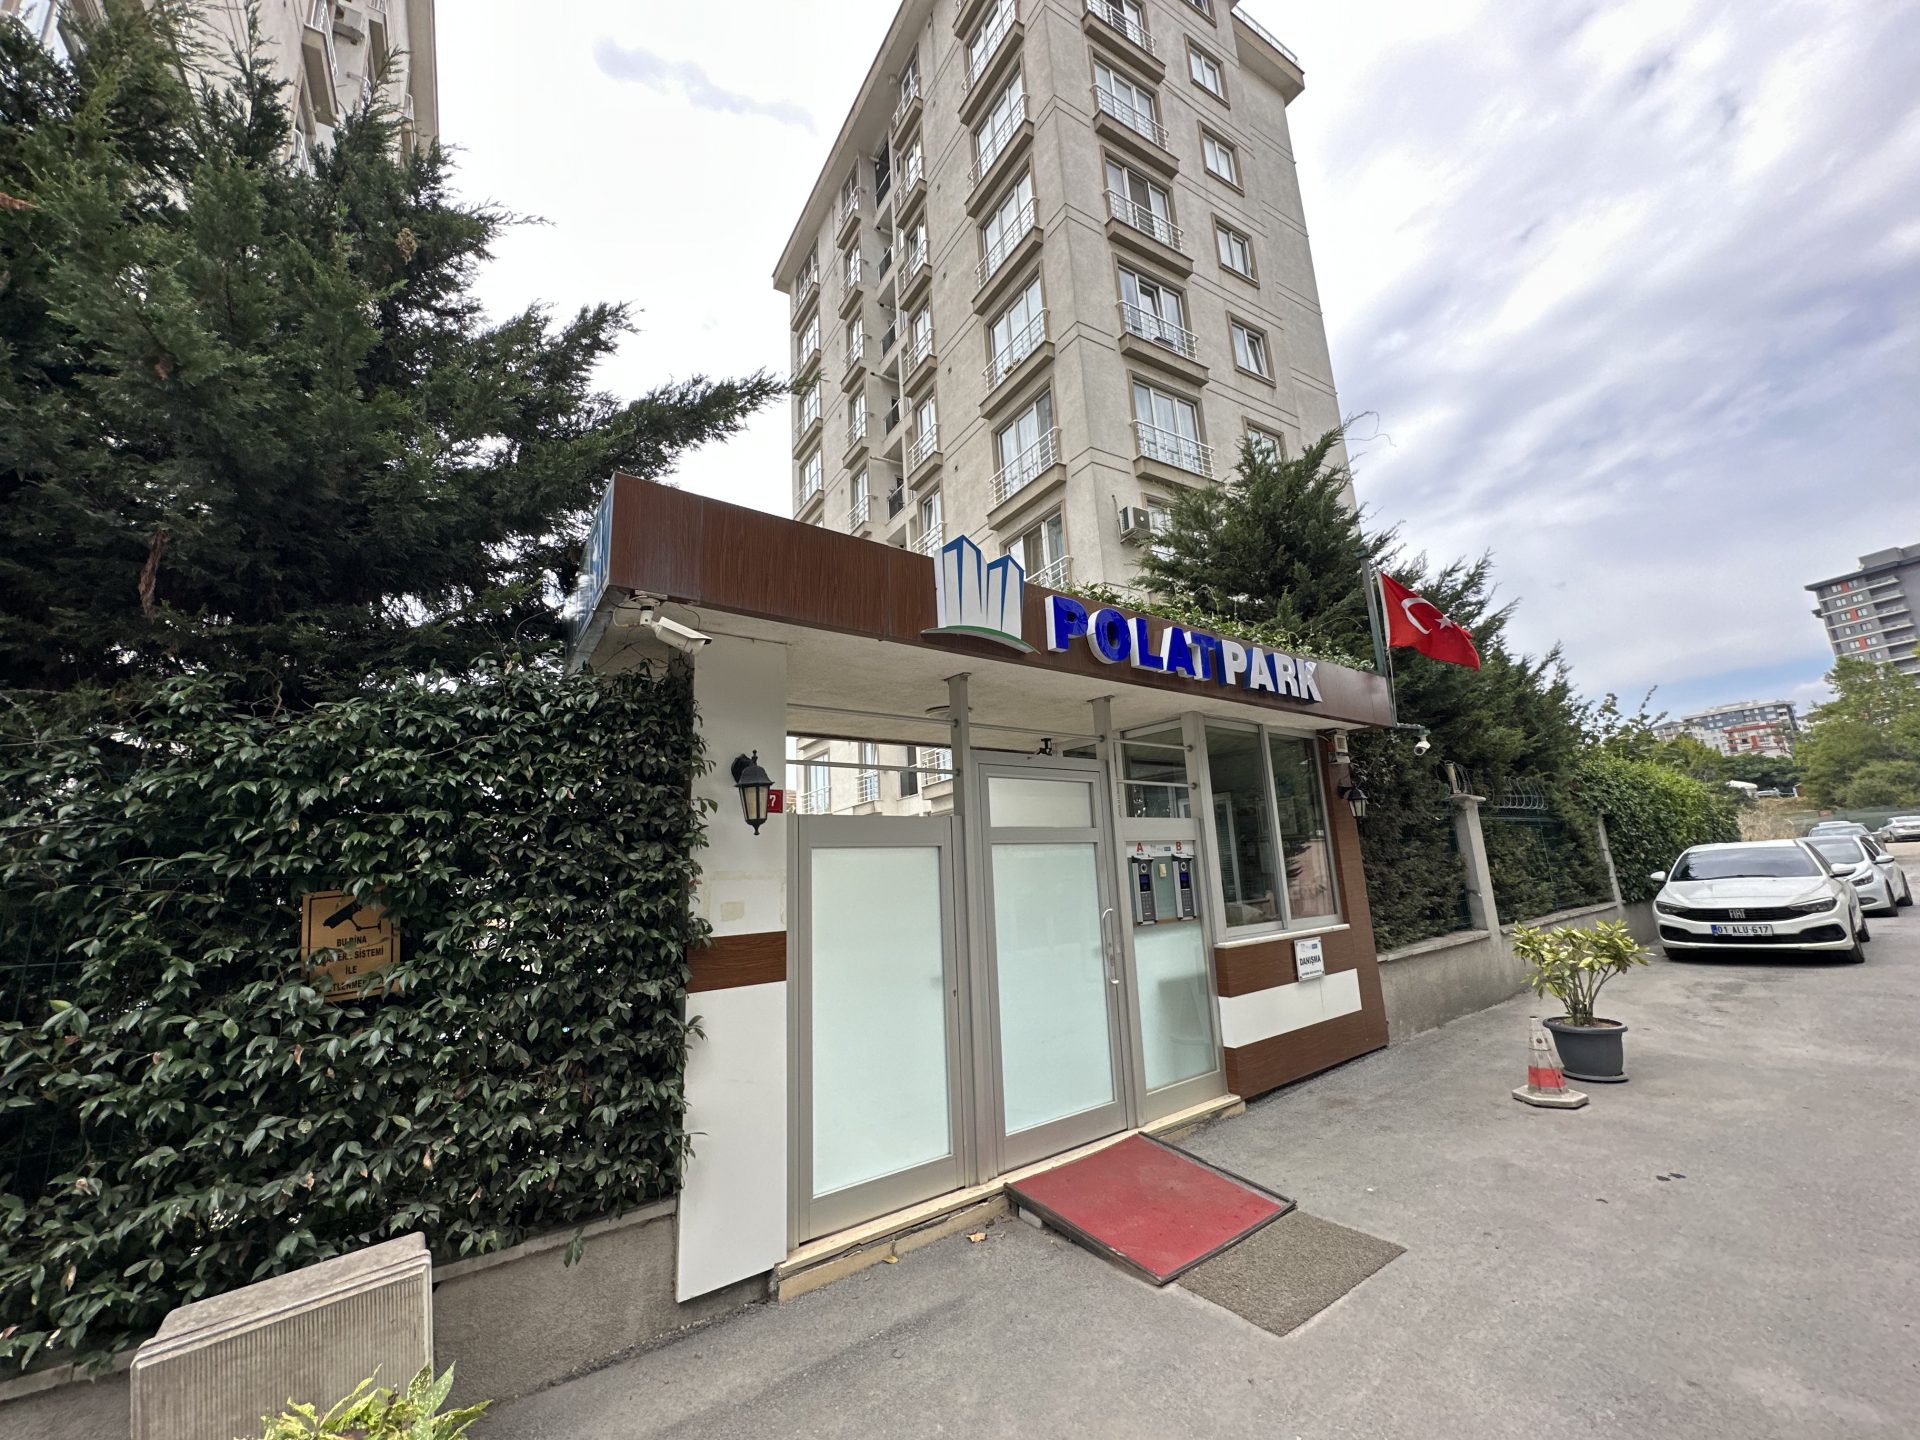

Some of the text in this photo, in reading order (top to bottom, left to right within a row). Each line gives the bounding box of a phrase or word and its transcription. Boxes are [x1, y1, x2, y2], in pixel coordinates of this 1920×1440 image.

[1045, 594, 1322, 703] POLAT PARK
[1136, 842, 1144, 852] A
[1176, 841, 1182, 851] B
[1728, 908, 1746, 919] FIAT
[1718, 926, 1769, 934] 01 ALU 617
[354, 946, 384, 959] SİSTEMİ
[345, 965, 358, 975] İLE
